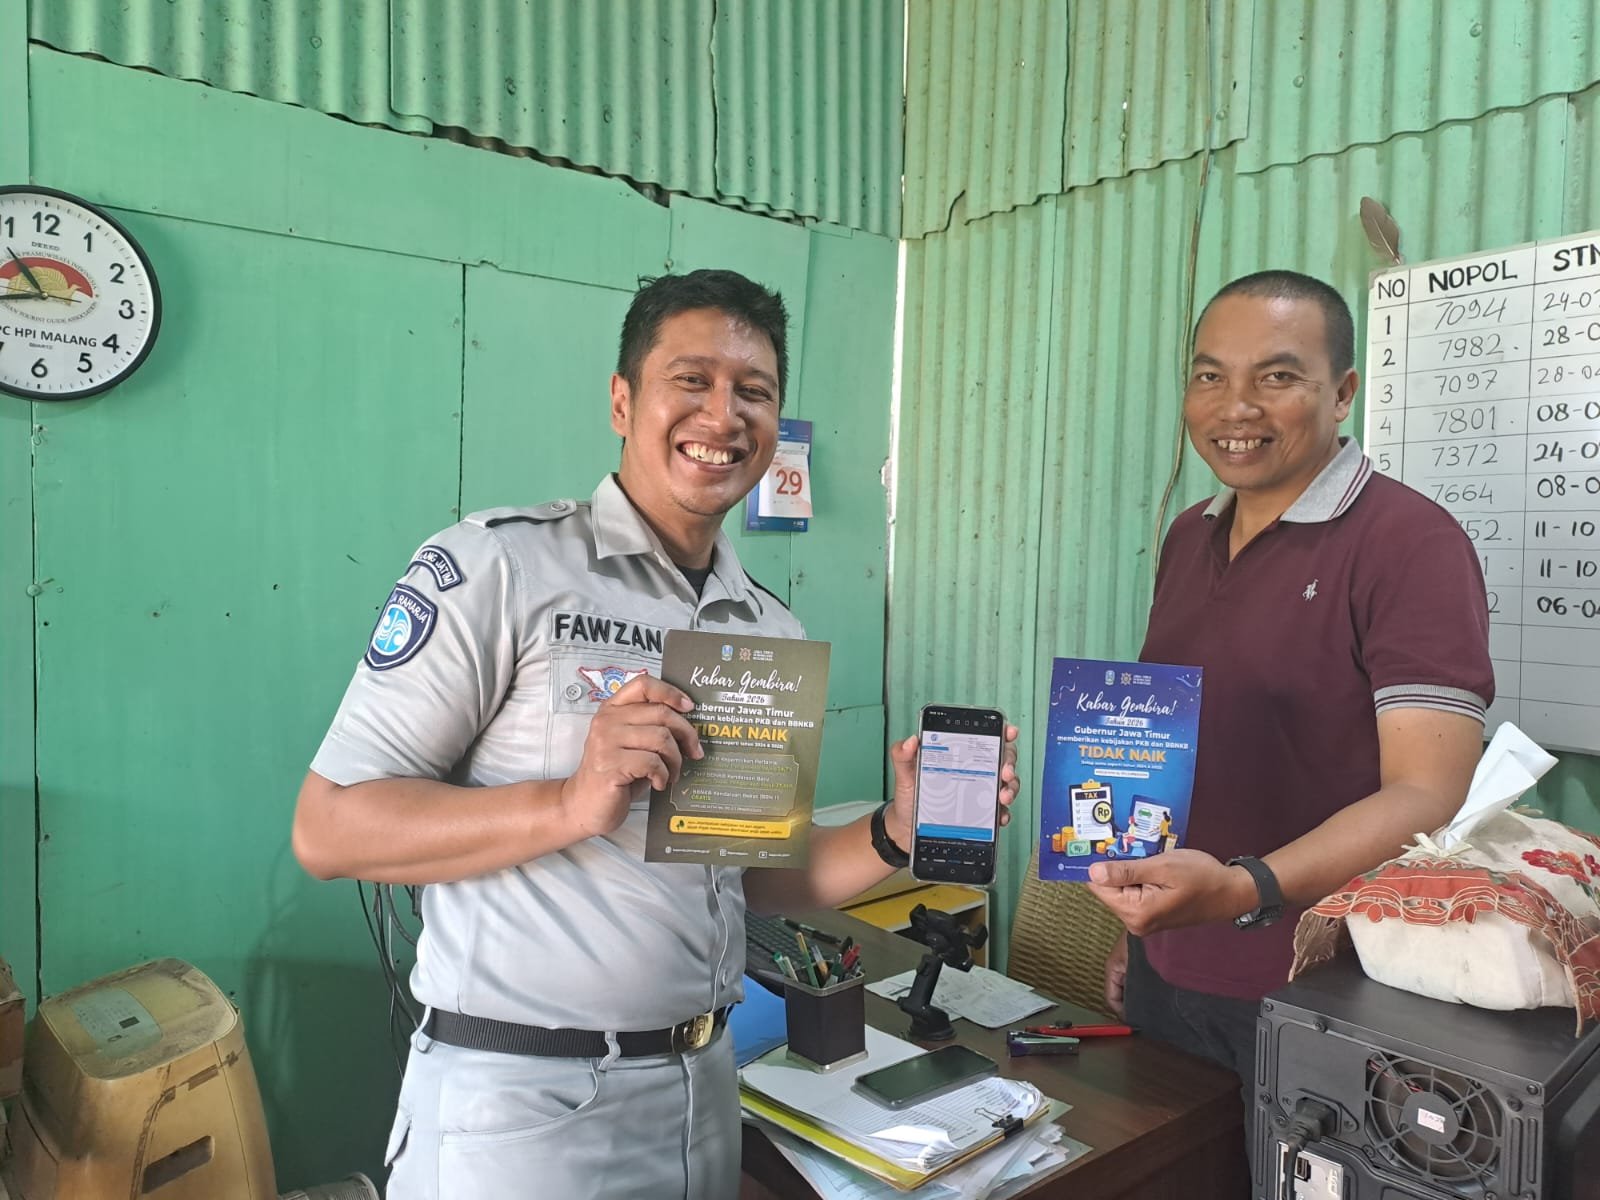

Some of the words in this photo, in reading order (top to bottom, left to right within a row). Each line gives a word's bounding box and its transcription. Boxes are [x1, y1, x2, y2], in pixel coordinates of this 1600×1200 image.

[32, 211, 60, 236] 12
[83, 232, 92, 252] 1
[110, 263, 124, 284] 2
[1378, 278, 1406, 300] NO
[1429, 260, 1518, 293] NOPOL
[119, 299, 135, 320] 3
[1384, 314, 1391, 336] 1
[1435, 297, 1507, 330] 7094
[14, 327, 36, 339] HPI
[40, 330, 96, 348] MALANG
[102, 334, 120, 354] 4
[77, 353, 93, 373] 5
[1382, 348, 1396, 367] 2
[31, 358, 48, 378] 6
[1380, 384, 1393, 404] 3
[1434, 369, 1498, 396] 7097
[1380, 416, 1392, 436] 4
[1379, 453, 1391, 472] 5
[1432, 443, 1498, 467] 7372
[1533, 442, 1600, 464] 24-0
[776, 469, 803, 496] 29
[1431, 482, 1494, 504] 7664
[398, 594, 428, 624] RAHARJA
[555, 614, 662, 654] FAWZAN
[690, 664, 736, 688] Kabar
[738, 670, 802, 694] Gembira!
[722, 693, 745, 704] Tahun
[746, 694, 765, 704] 2026
[1076, 690, 1118, 712] Kabar
[1120, 694, 1178, 719] Gembira!
[717, 714, 754, 725] kebijakan
[755, 718, 770, 726] PKB
[772, 718, 786, 727] dan
[788, 720, 814, 728] BBNKB
[738, 706, 763, 716] Jawa
[765, 708, 794, 718] Timur
[694, 722, 743, 738] TIDAK
[747, 726, 788, 742] NAIK
[1126, 718, 1144, 727] 2026
[1057, 735, 1099, 743] memberikan
[1101, 736, 1137, 746] kebijakan
[1150, 740, 1164, 748] dan
[1165, 742, 1189, 750] BBNKB
[1074, 726, 1116, 736] Gubernur
[1119, 729, 1142, 738] Jawa
[1144, 730, 1171, 740] Timur
[1078, 744, 1125, 760] TIDAK
[1130, 748, 1168, 763] NAIK
[1084, 792, 1099, 800] TAX
[1098, 807, 1110, 818] Rp
